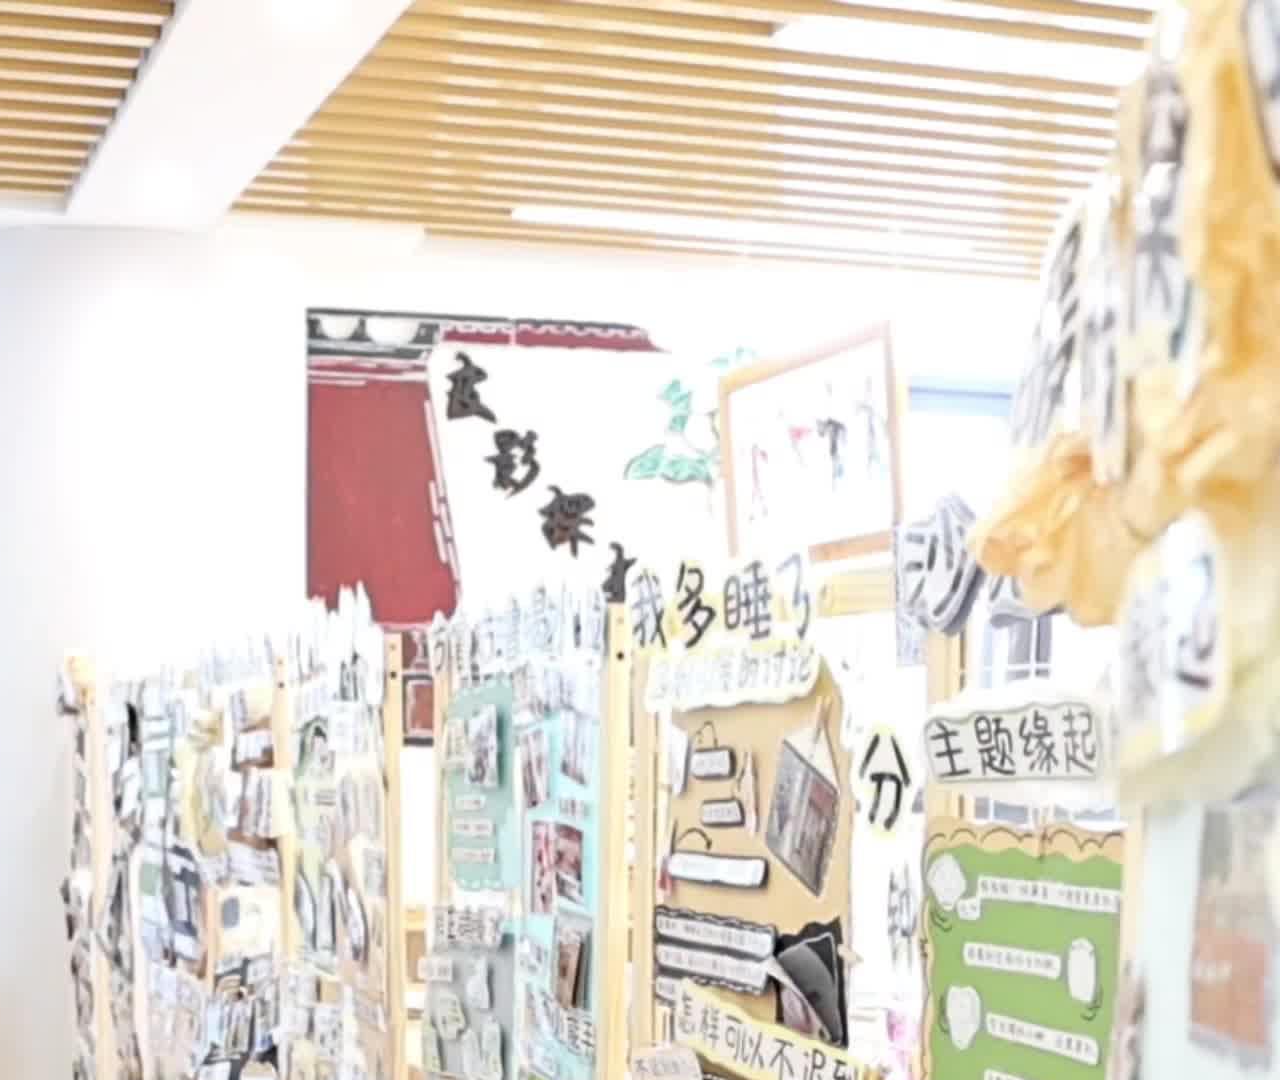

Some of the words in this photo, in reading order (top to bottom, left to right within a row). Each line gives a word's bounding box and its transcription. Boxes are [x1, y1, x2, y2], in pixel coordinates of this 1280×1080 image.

[631, 554, 812, 649] 我多睡了
[933, 710, 1095, 778] 主题缘起
